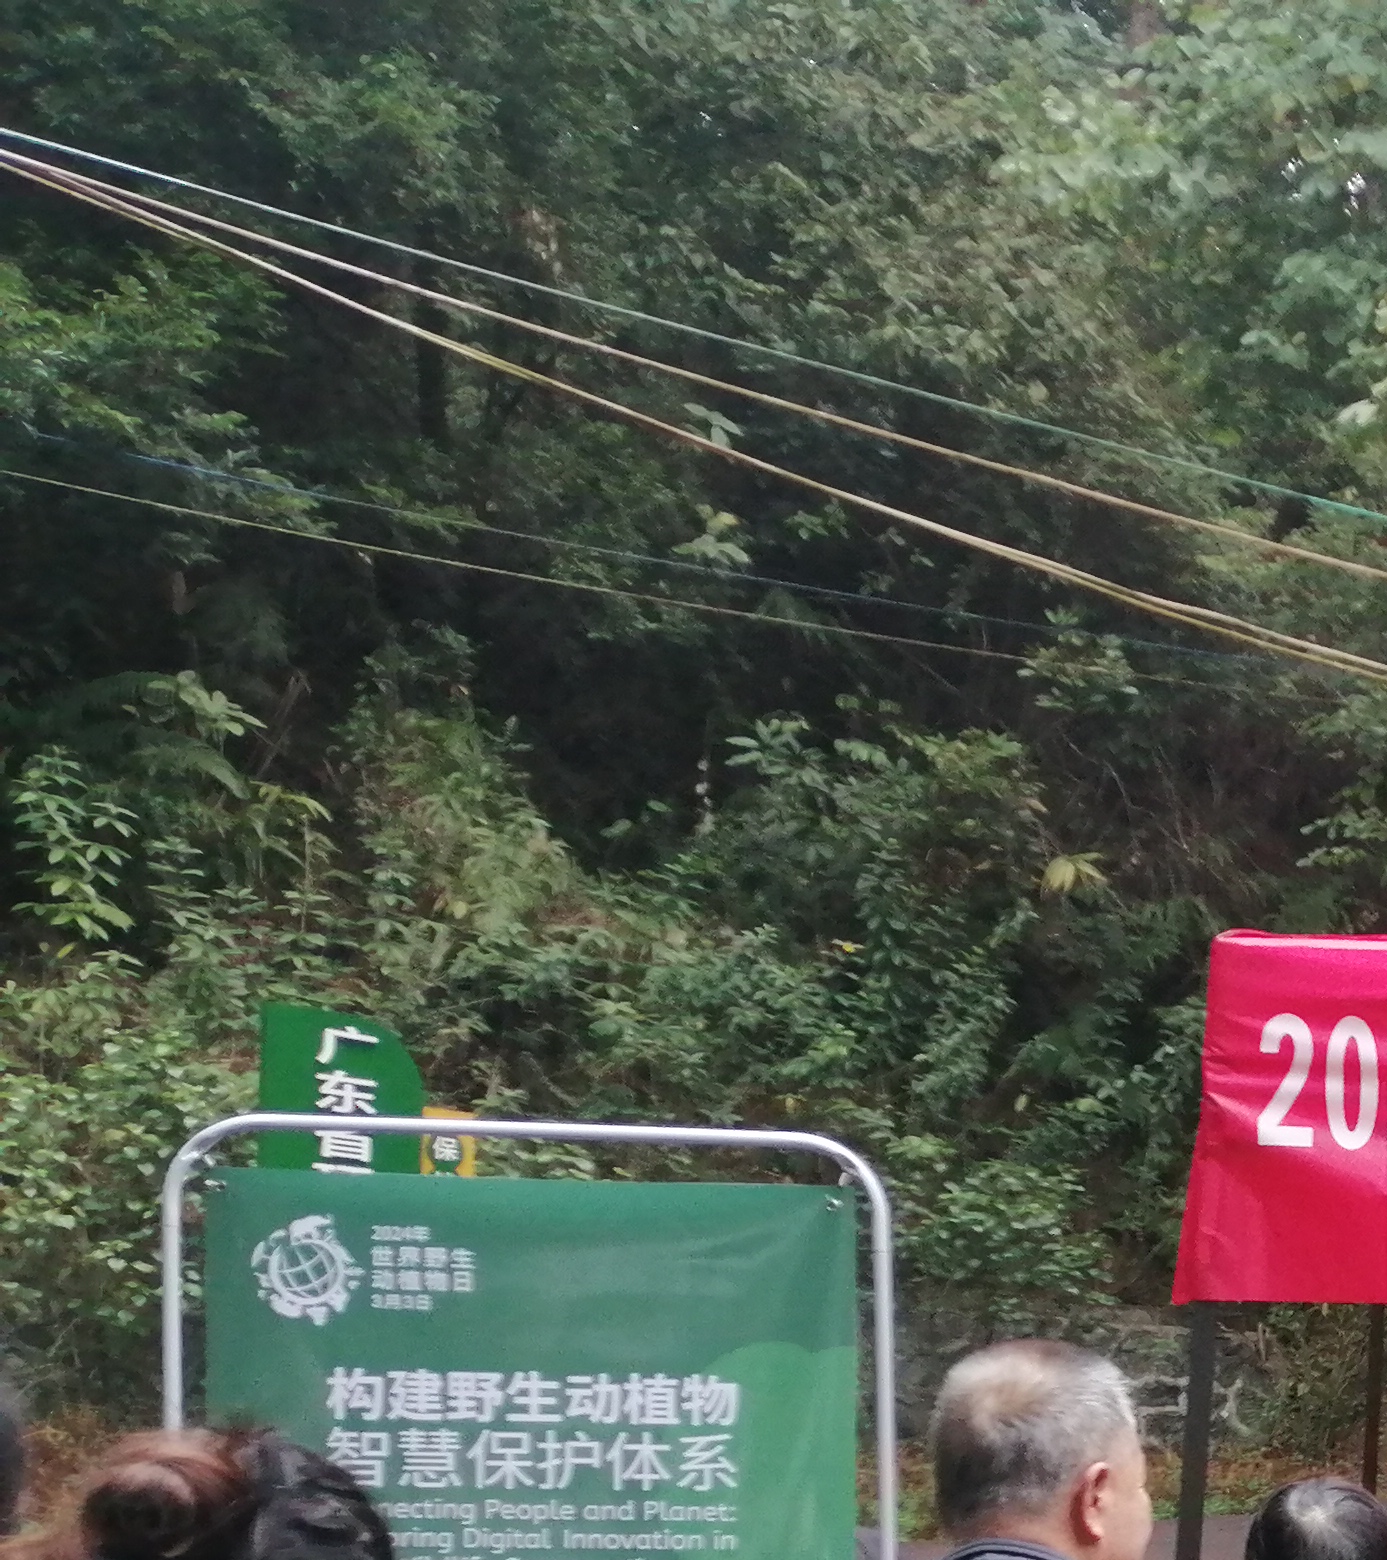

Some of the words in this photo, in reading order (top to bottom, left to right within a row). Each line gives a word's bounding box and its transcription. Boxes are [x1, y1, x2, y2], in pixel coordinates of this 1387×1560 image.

[312, 1026, 380, 1174] 广东首
[325, 1366, 741, 1427] 构建野生动植物
[325, 1427, 740, 1492] 智慧保护体系
[377, 1499, 477, 1525] necting
[484, 1499, 577, 1525] People
[582, 1500, 636, 1521] and
[643, 1500, 739, 1523] Planet:
[389, 1527, 455, 1553] oring
[462, 1527, 553, 1553] Digital
[562, 1528, 705, 1551] Innovation
[712, 1529, 738, 1551] in
